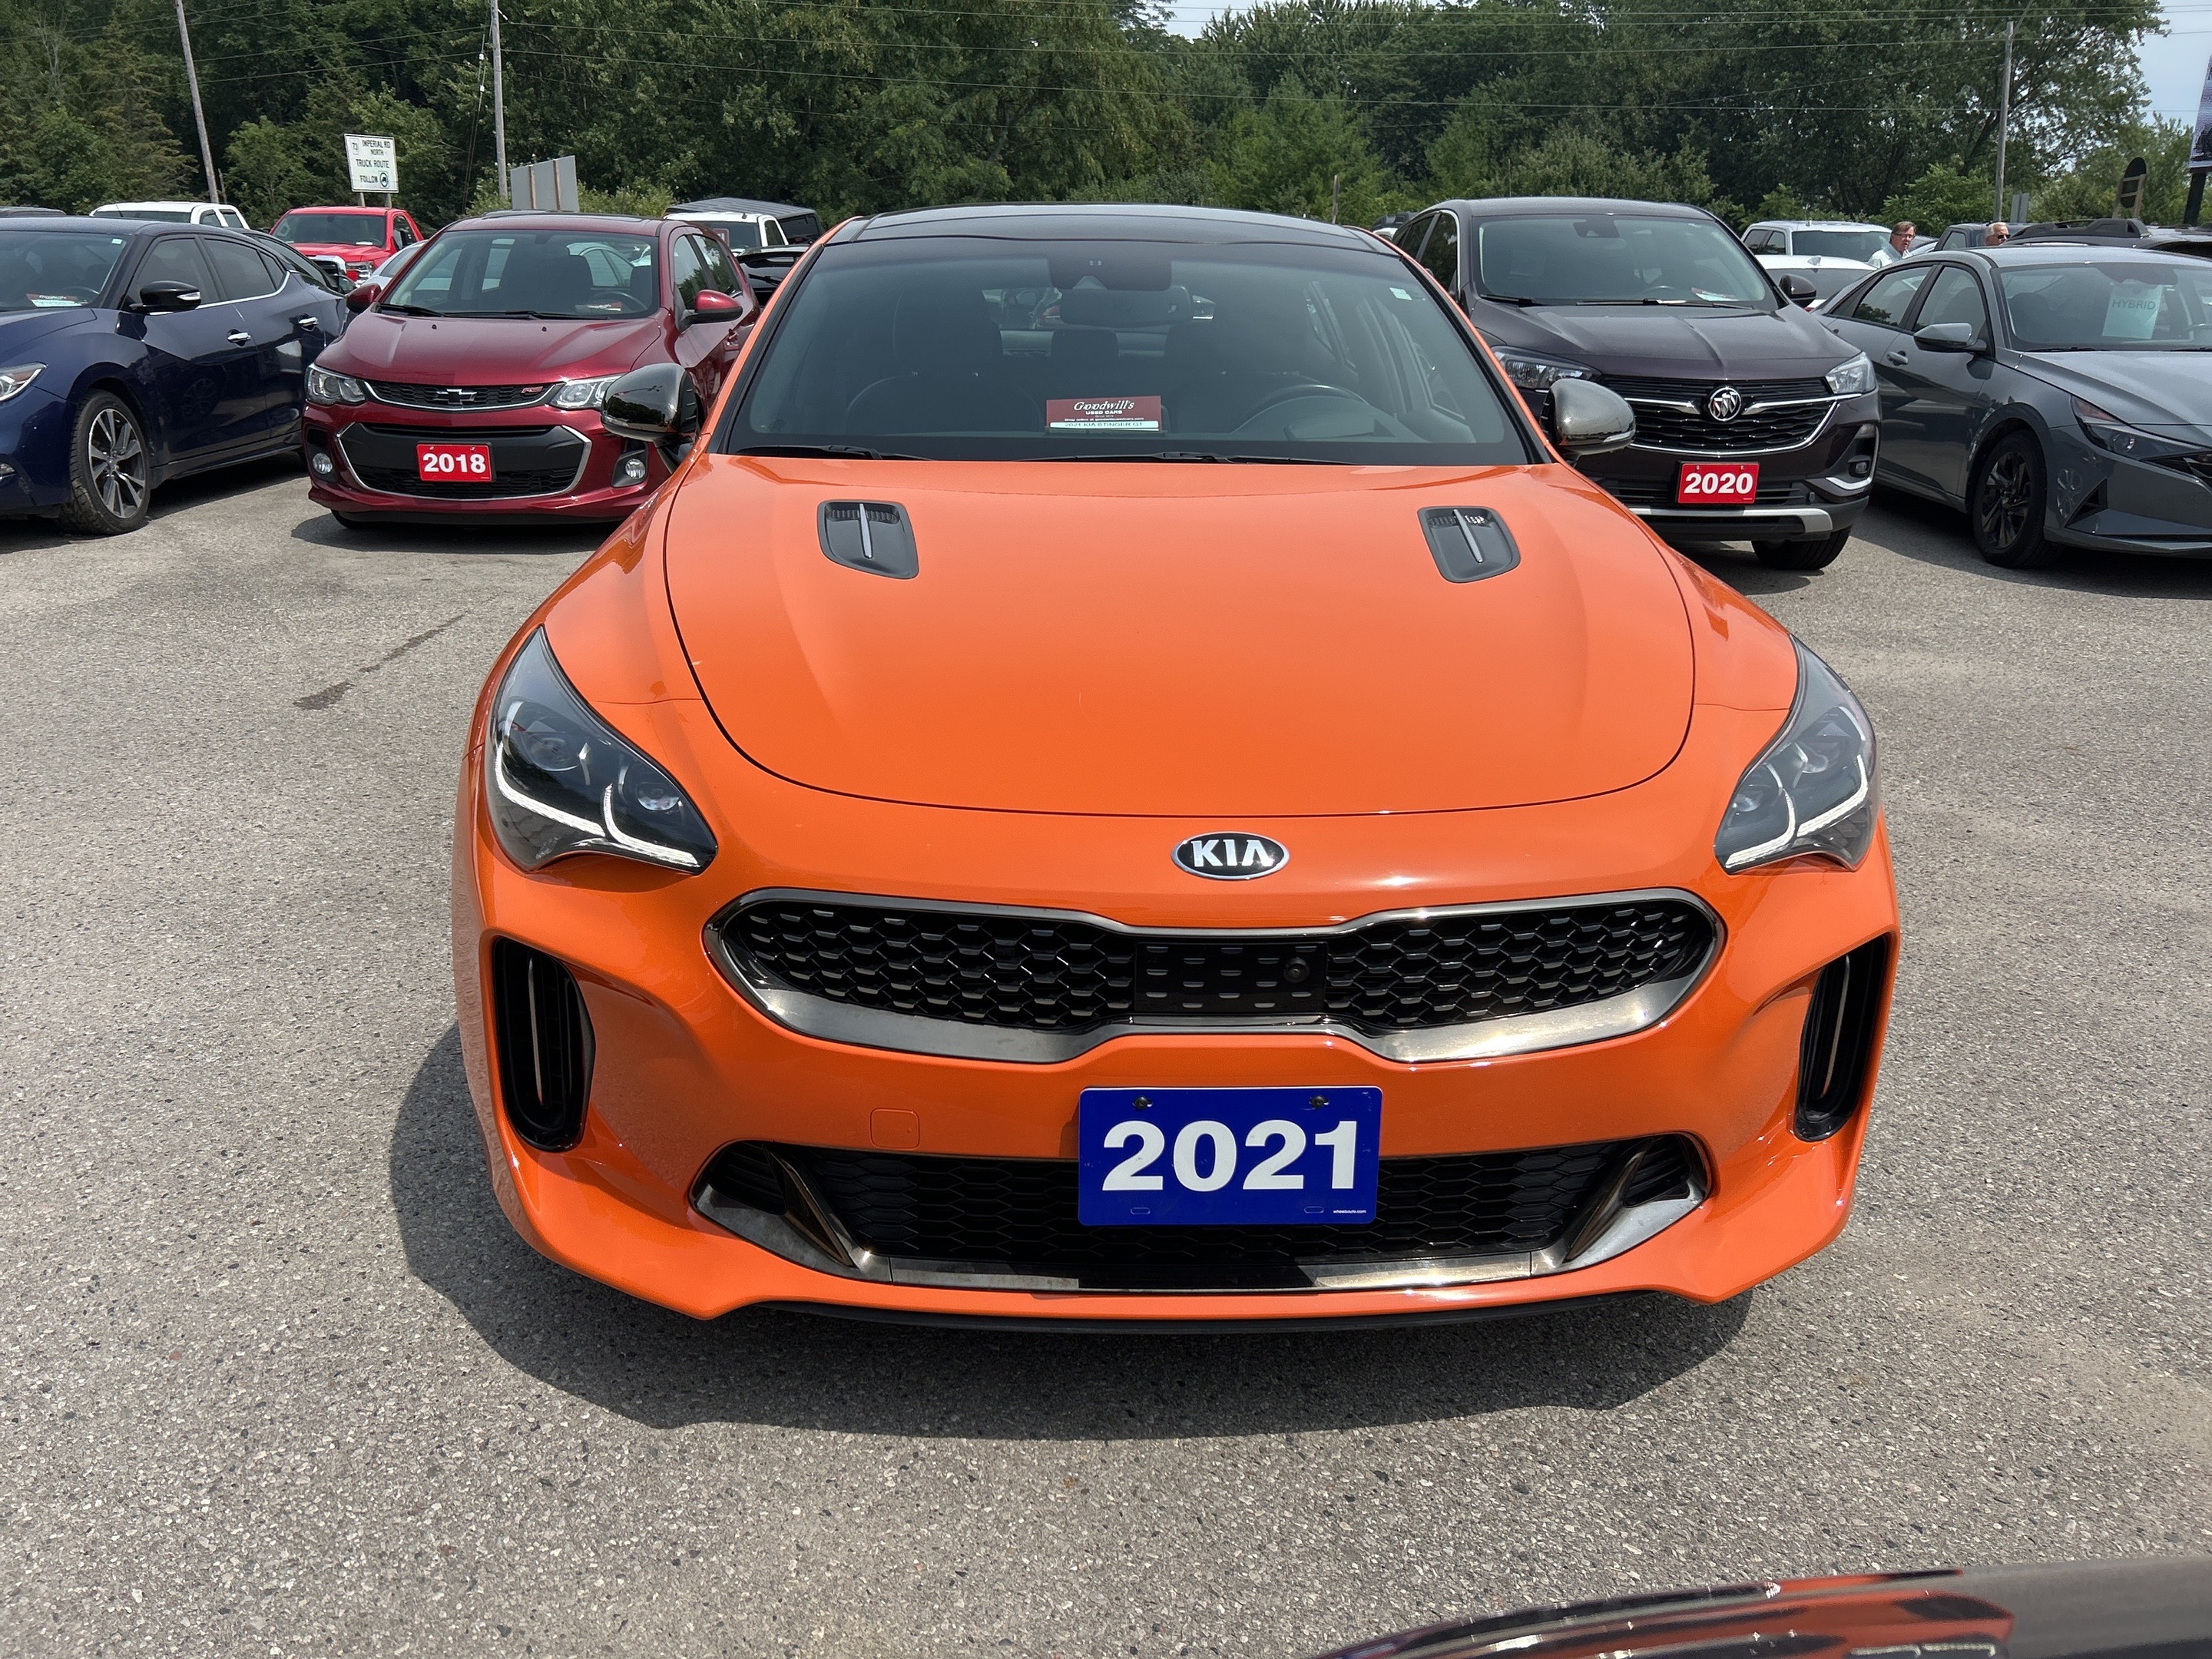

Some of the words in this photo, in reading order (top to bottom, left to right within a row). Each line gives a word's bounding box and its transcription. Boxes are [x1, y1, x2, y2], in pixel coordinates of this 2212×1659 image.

[362, 140, 383, 148] IMPERIAL
[356, 159, 373, 167] TRUCK
[373, 160, 389, 168] ROUTE
[359, 175, 378, 184] FOLLOW
[2112, 299, 2156, 310] HYBRID
[1073, 400, 1135, 411] Goodwill's
[423, 453, 486, 474] 2018
[1684, 472, 1753, 495] 2020
[1190, 839, 1275, 868] KIA
[1101, 1119, 1358, 1192] 2021
